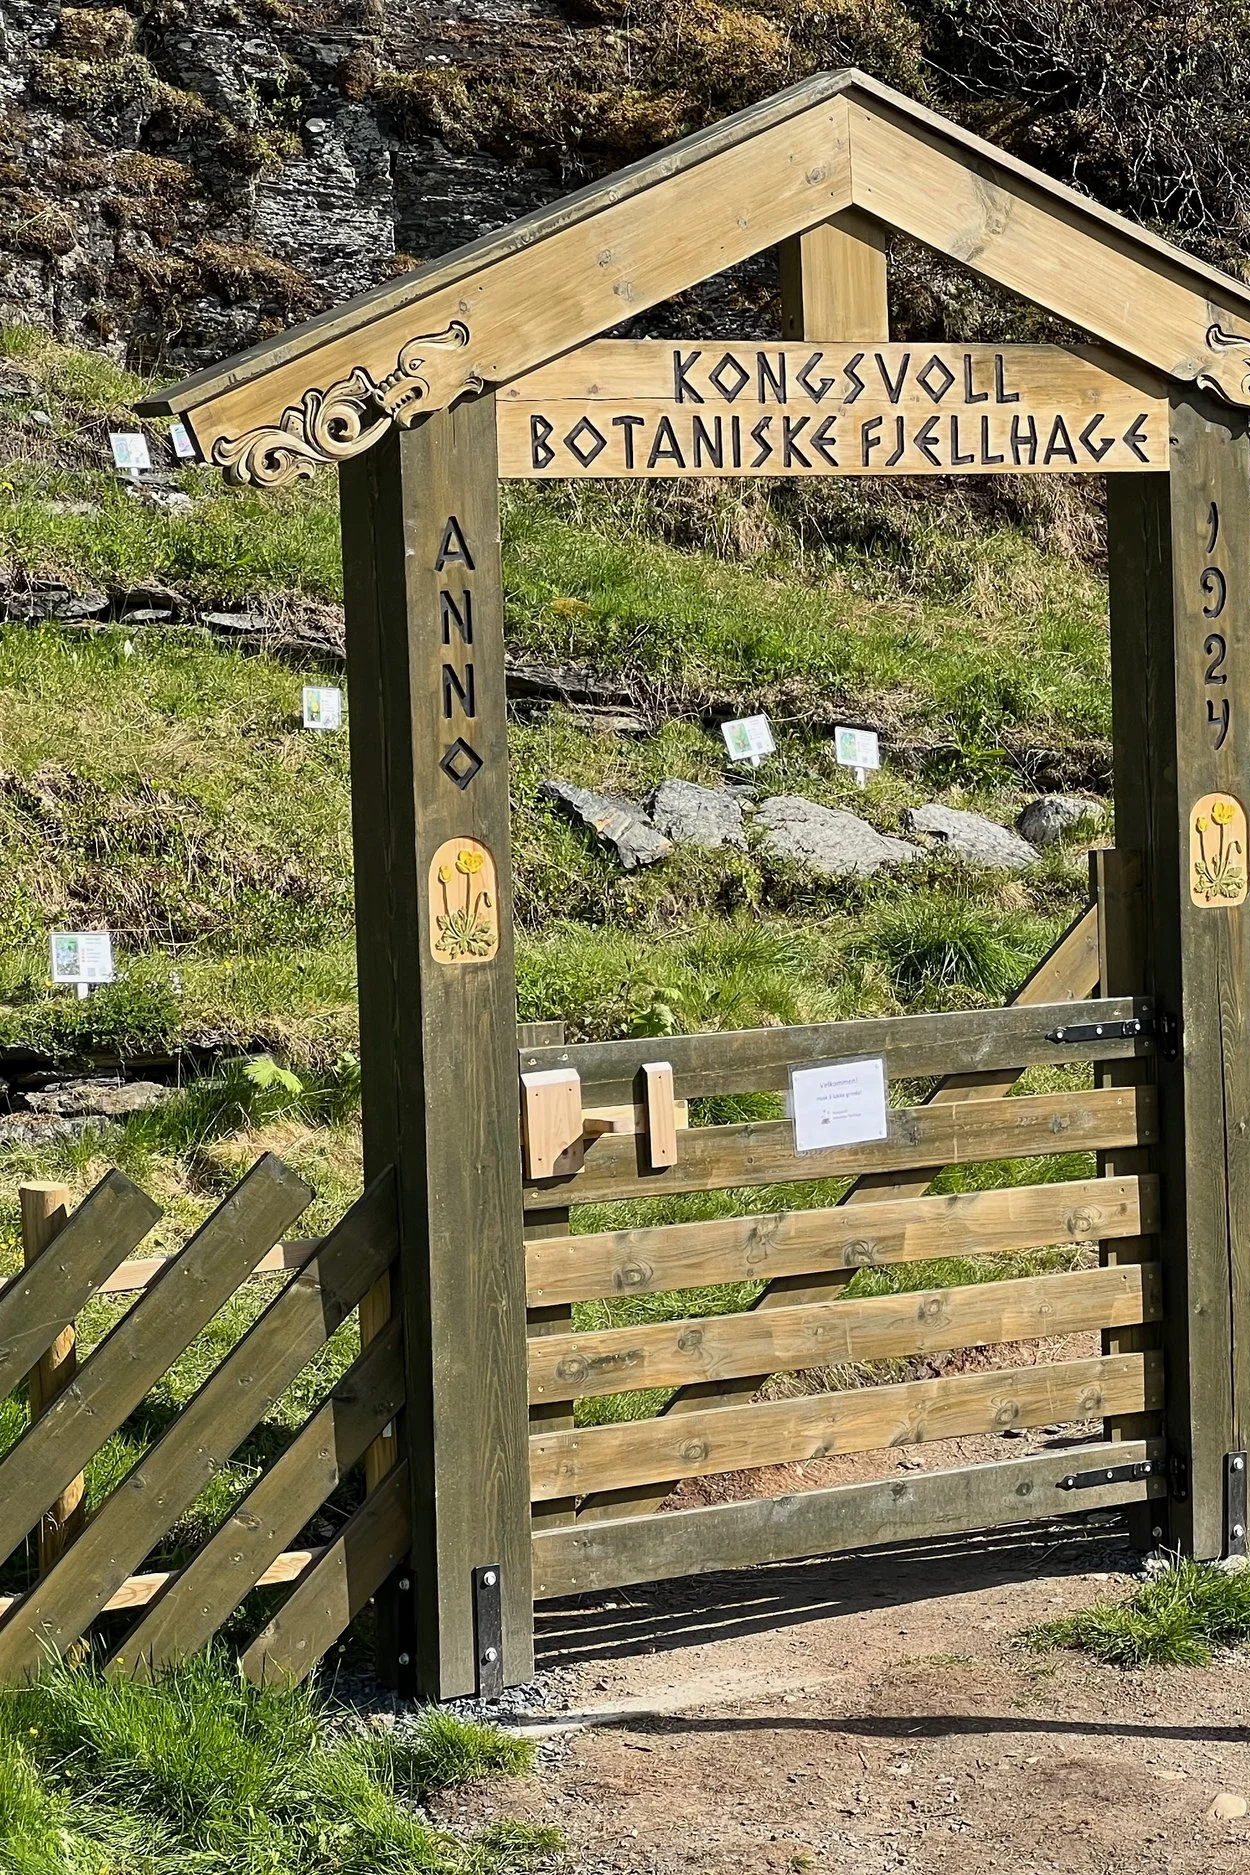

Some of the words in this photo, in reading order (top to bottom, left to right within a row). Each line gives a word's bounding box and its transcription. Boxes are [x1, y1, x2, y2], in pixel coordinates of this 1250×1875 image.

[530, 414, 838, 470] BOTANISKE
[861, 412, 1151, 468] FJELLHAGE
[673, 350, 1020, 405] KONGSVOLL
[434, 515, 483, 791] ANNO
[1199, 501, 1231, 750] 1924
